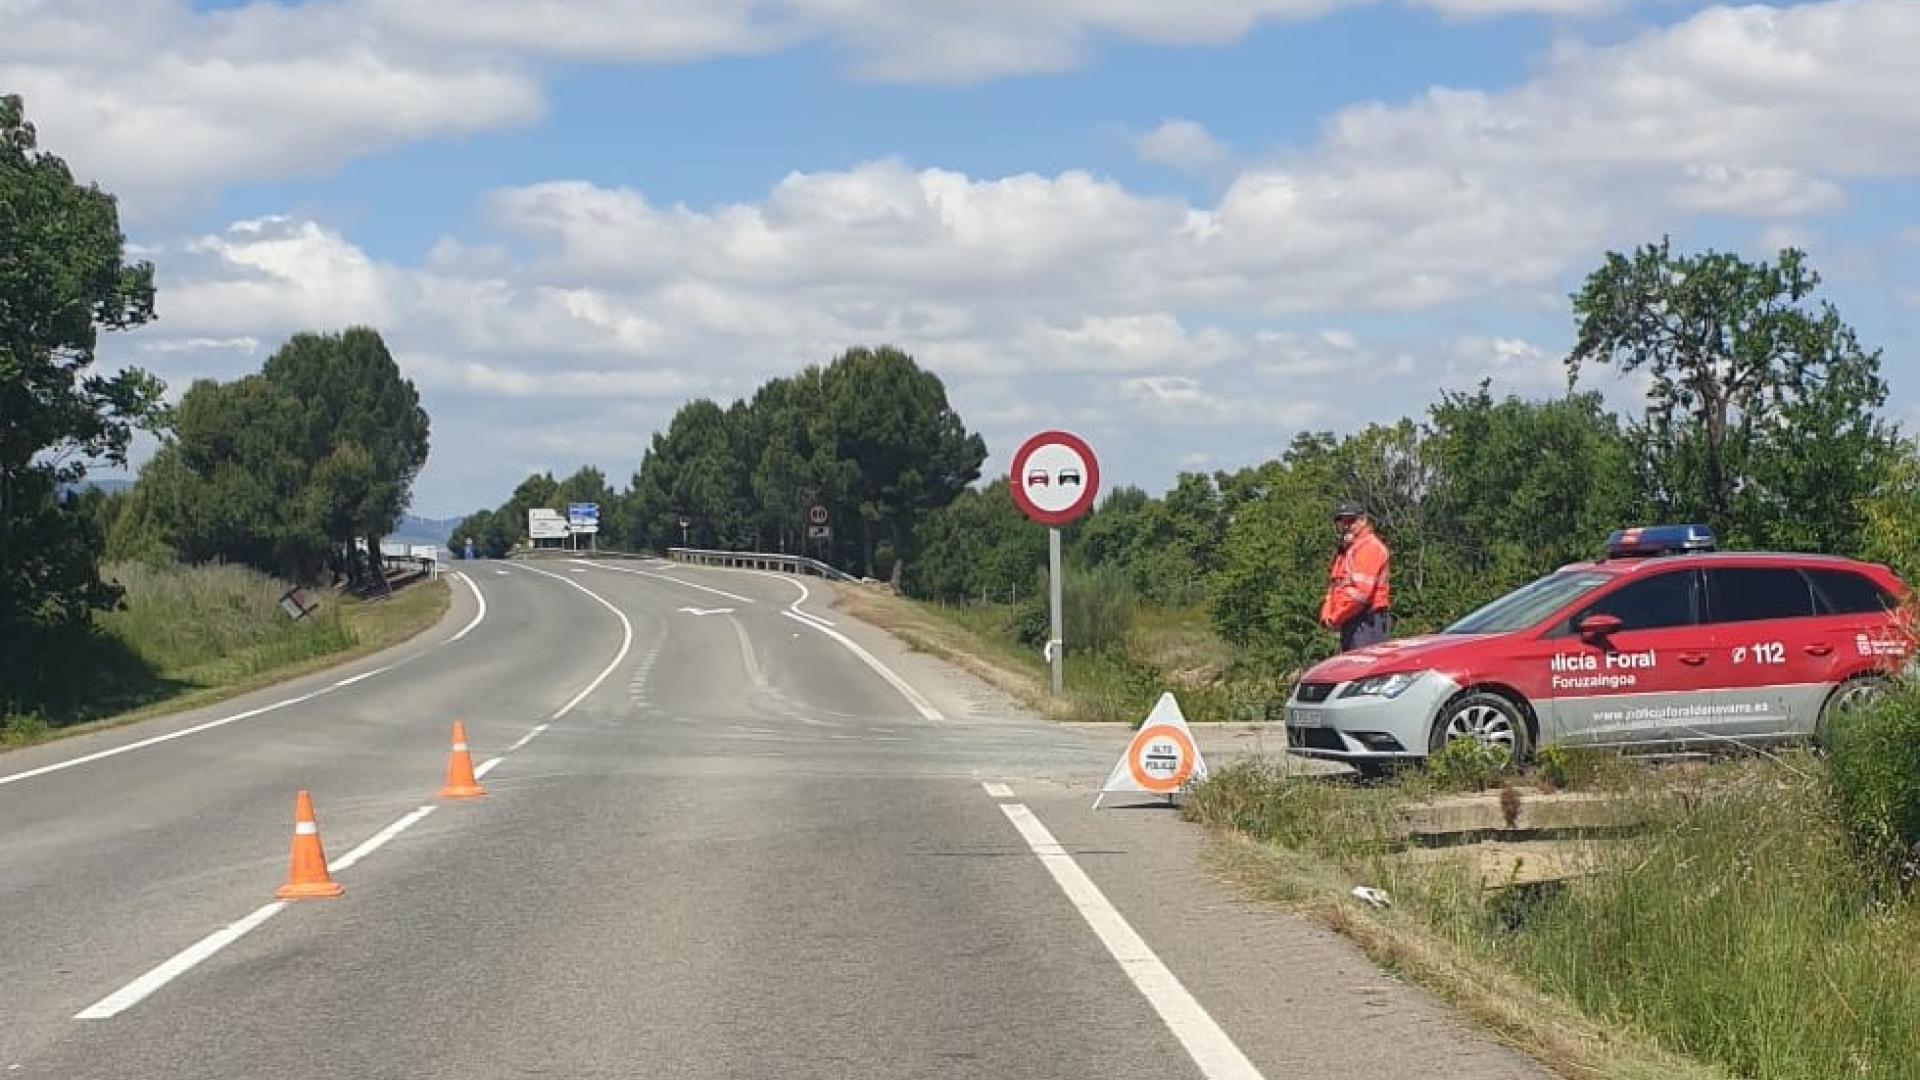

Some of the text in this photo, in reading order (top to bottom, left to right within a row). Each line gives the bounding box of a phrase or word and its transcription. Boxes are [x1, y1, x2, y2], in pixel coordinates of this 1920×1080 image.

[1606, 649, 1656, 669] Foral
[1752, 641, 1786, 665] 112
[1553, 673, 1637, 689] Foruzaingoa
